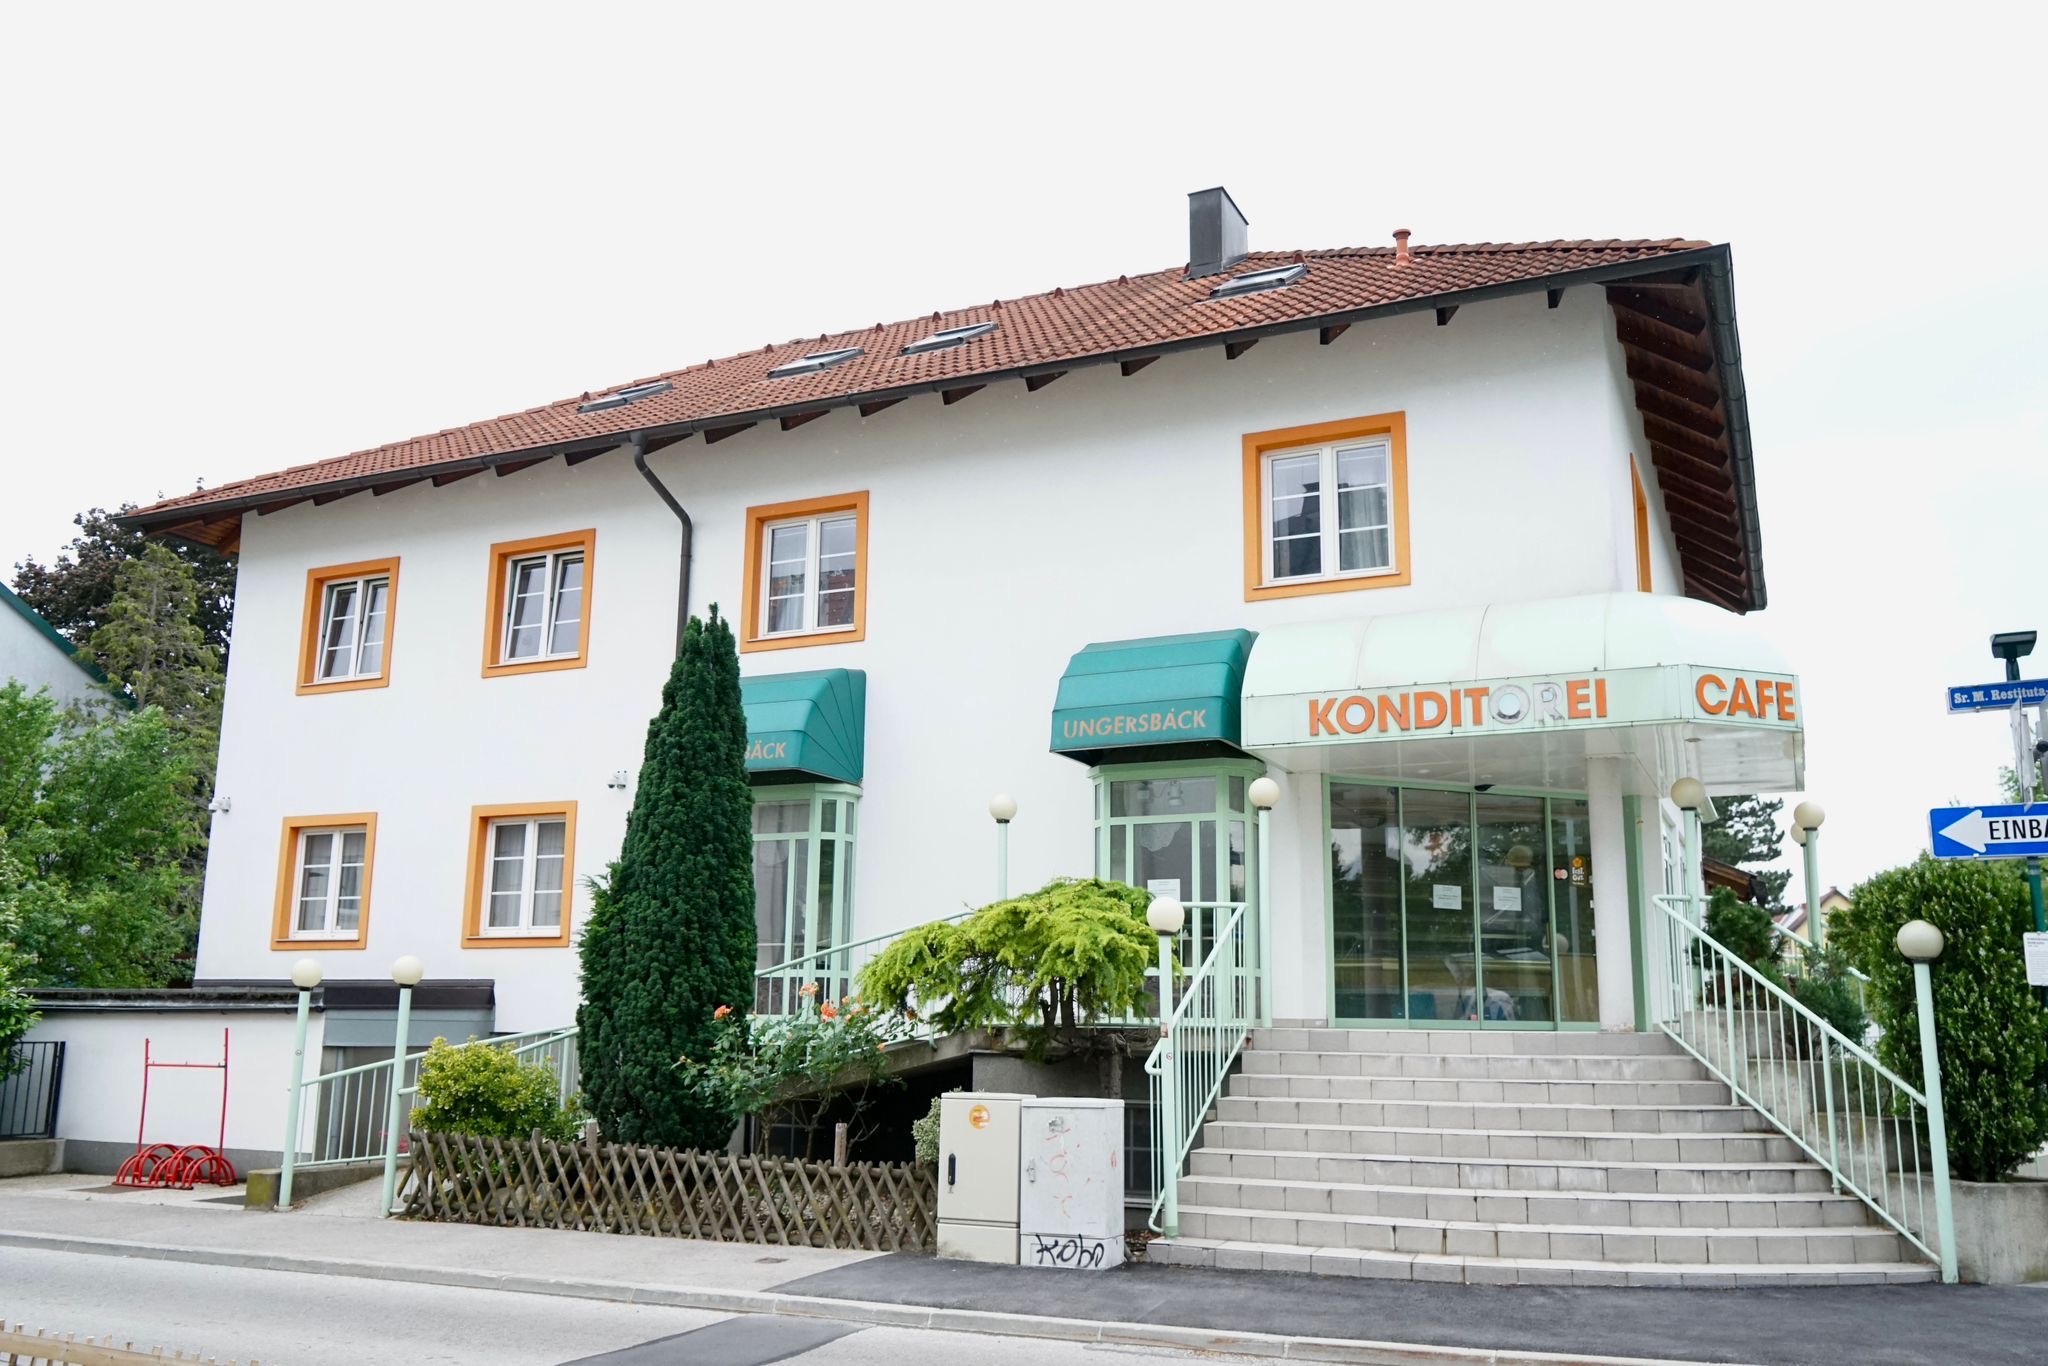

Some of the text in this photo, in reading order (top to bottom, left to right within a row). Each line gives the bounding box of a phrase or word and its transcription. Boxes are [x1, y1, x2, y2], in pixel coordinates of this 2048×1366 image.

[1308, 678, 1608, 737] KONDITOREI
[1695, 673, 1796, 721] CAFE
[1954, 692, 1970, 704] Sr.
[1972, 690, 1989, 702] M.
